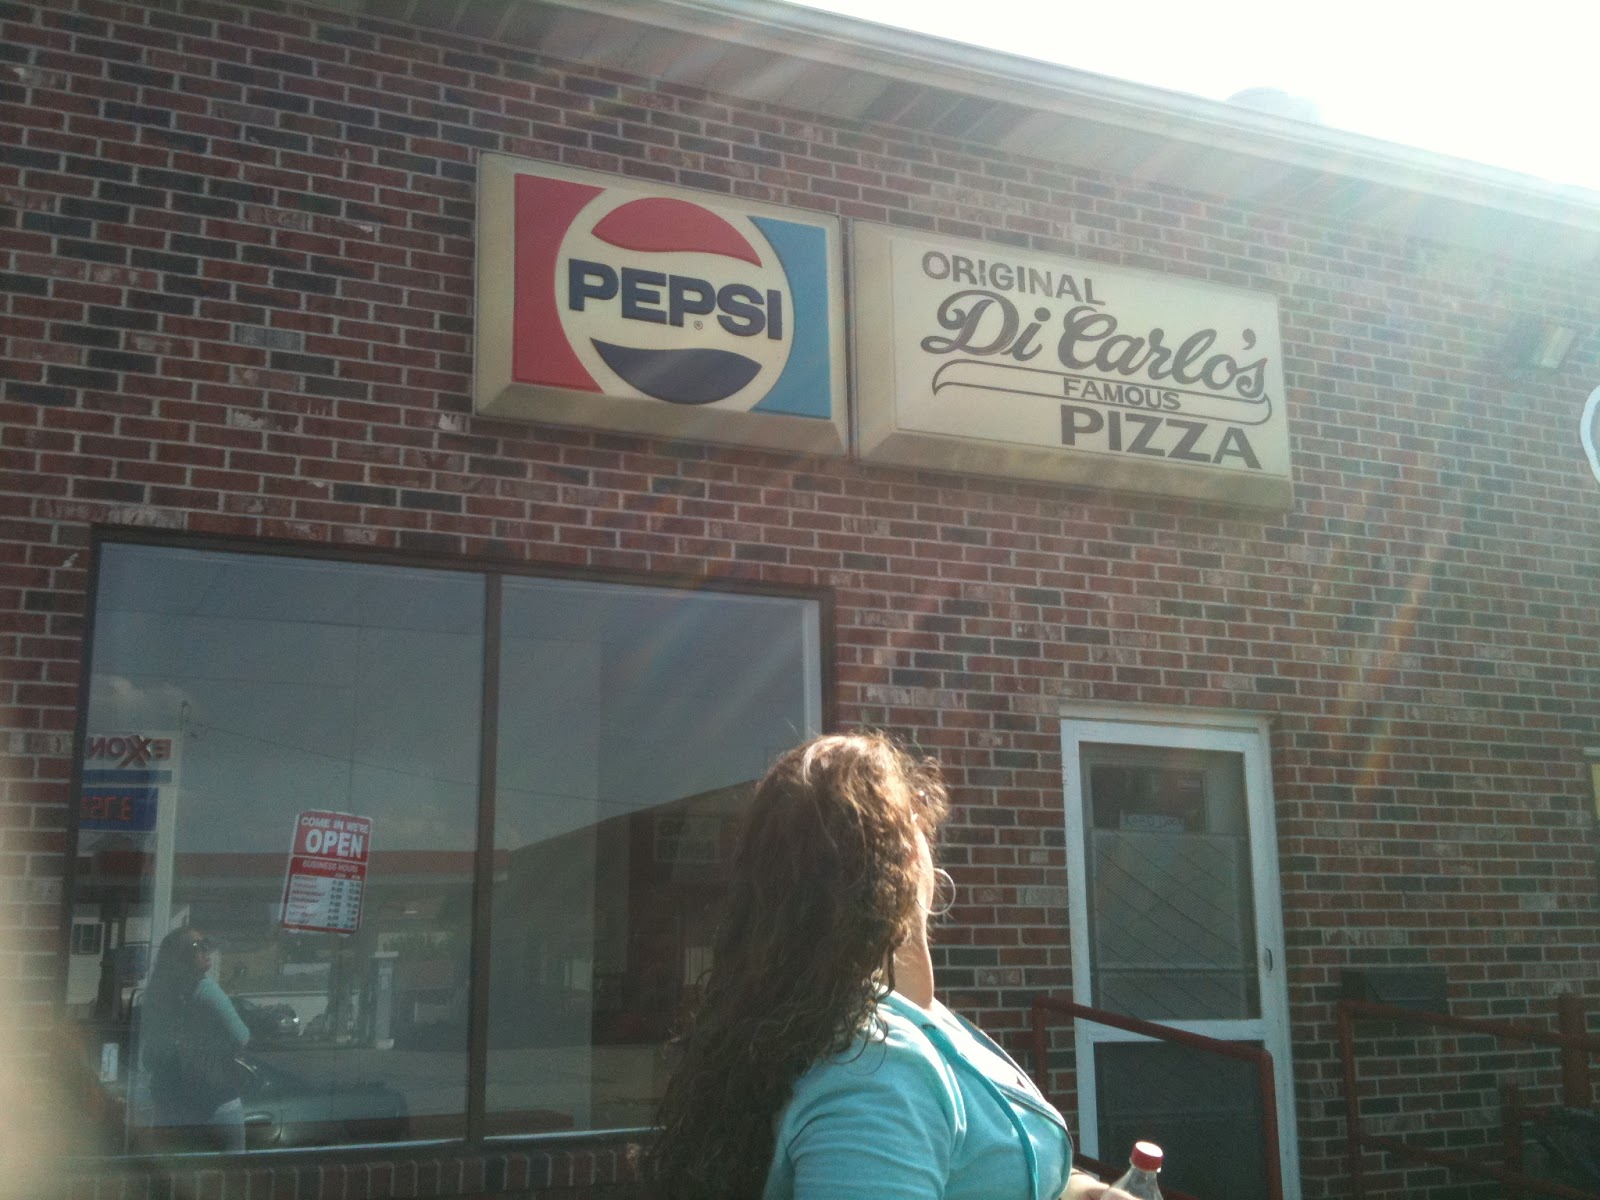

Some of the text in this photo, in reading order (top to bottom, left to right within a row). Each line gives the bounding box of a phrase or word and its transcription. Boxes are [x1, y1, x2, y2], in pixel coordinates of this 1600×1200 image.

[568, 258, 783, 341] PEPSI
[921, 250, 1106, 306] ORIGINAL
[1063, 376, 1181, 411] FAMOUS
[1060, 404, 1263, 470] PIZZA
[301, 816, 330, 828] COME
[333, 819, 344, 830] IN
[305, 828, 364, 858] OPEN
